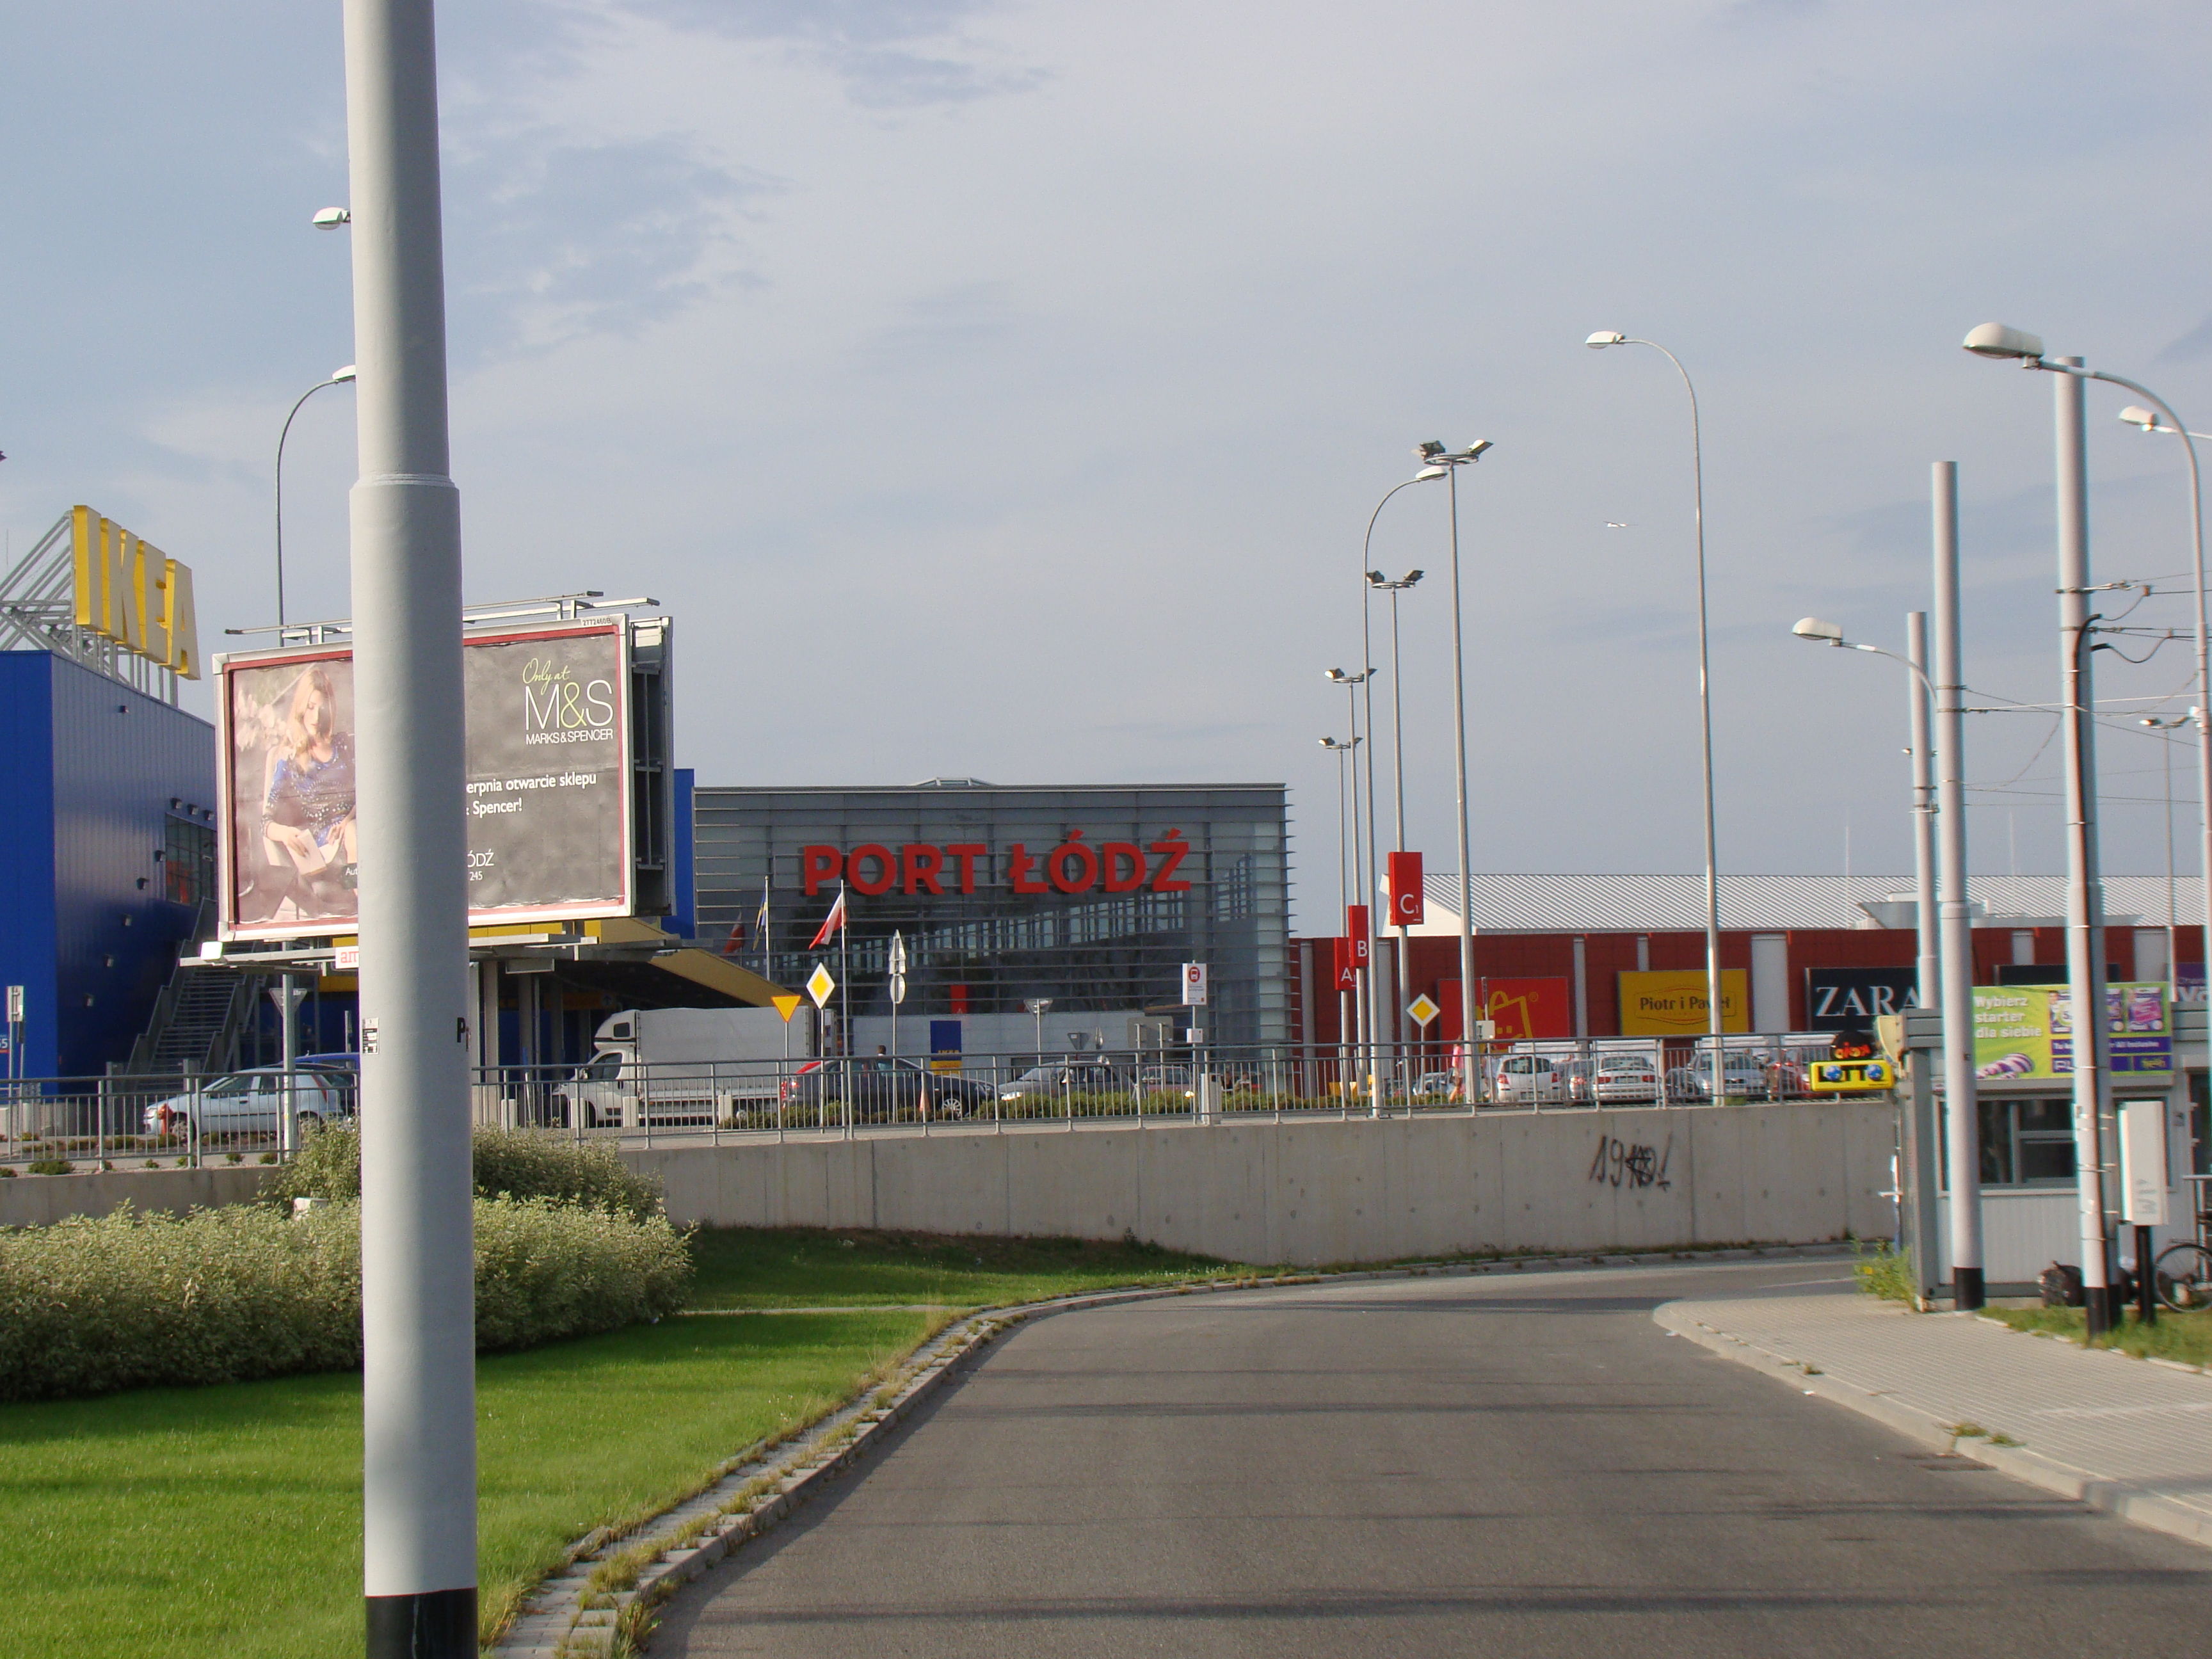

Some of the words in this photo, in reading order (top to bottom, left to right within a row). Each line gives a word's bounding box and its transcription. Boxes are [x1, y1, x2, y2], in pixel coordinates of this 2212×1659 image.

[73, 504, 200, 680] IKEA
[522, 657, 552, 696] Only
[554, 666, 571, 682] at
[525, 680, 614, 731] M&S
[505, 774, 557, 791] otwarcie
[559, 771, 597, 789] sklepu
[472, 797, 523, 819] Spencer!
[803, 844, 987, 896] PORT
[1008, 828, 1190, 894] ŁÓDŹ
[1358, 940, 1367, 957] B
[1640, 997, 1676, 1010] Piotr
[1680, 997, 1685, 1009] i
[1815, 986, 1920, 1016] ZARA
[1975, 996, 2028, 1009] Wybierz
[1975, 1012, 2025, 1023] starter
[1976, 1027, 1997, 1038] dla
[2001, 1026, 2042, 1037] siebie
